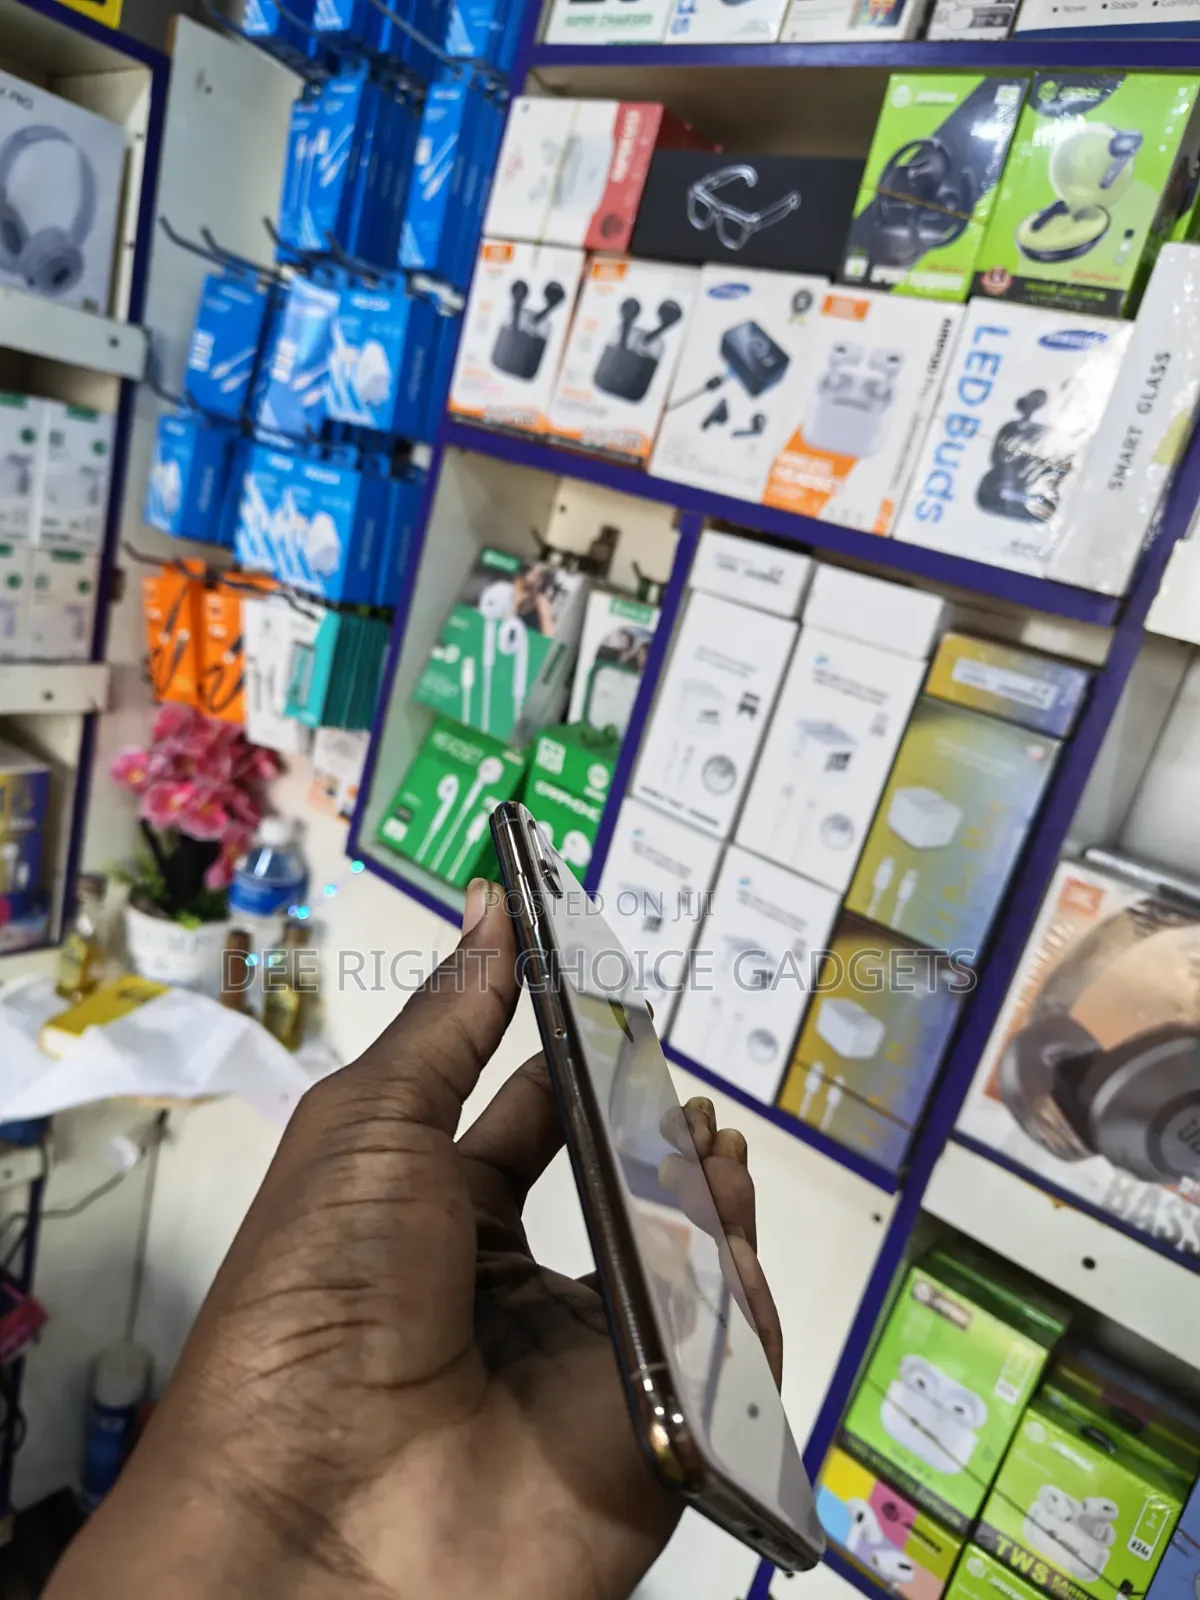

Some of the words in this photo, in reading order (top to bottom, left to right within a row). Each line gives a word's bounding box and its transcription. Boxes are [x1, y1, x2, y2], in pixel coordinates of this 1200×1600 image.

[958, 325, 1009, 408] LED
[915, 413, 981, 524] Buds
[1109, 425, 1144, 491] SMART
[1137, 352, 1172, 415] GLASS
[996, 1534, 1049, 1584] TWS
